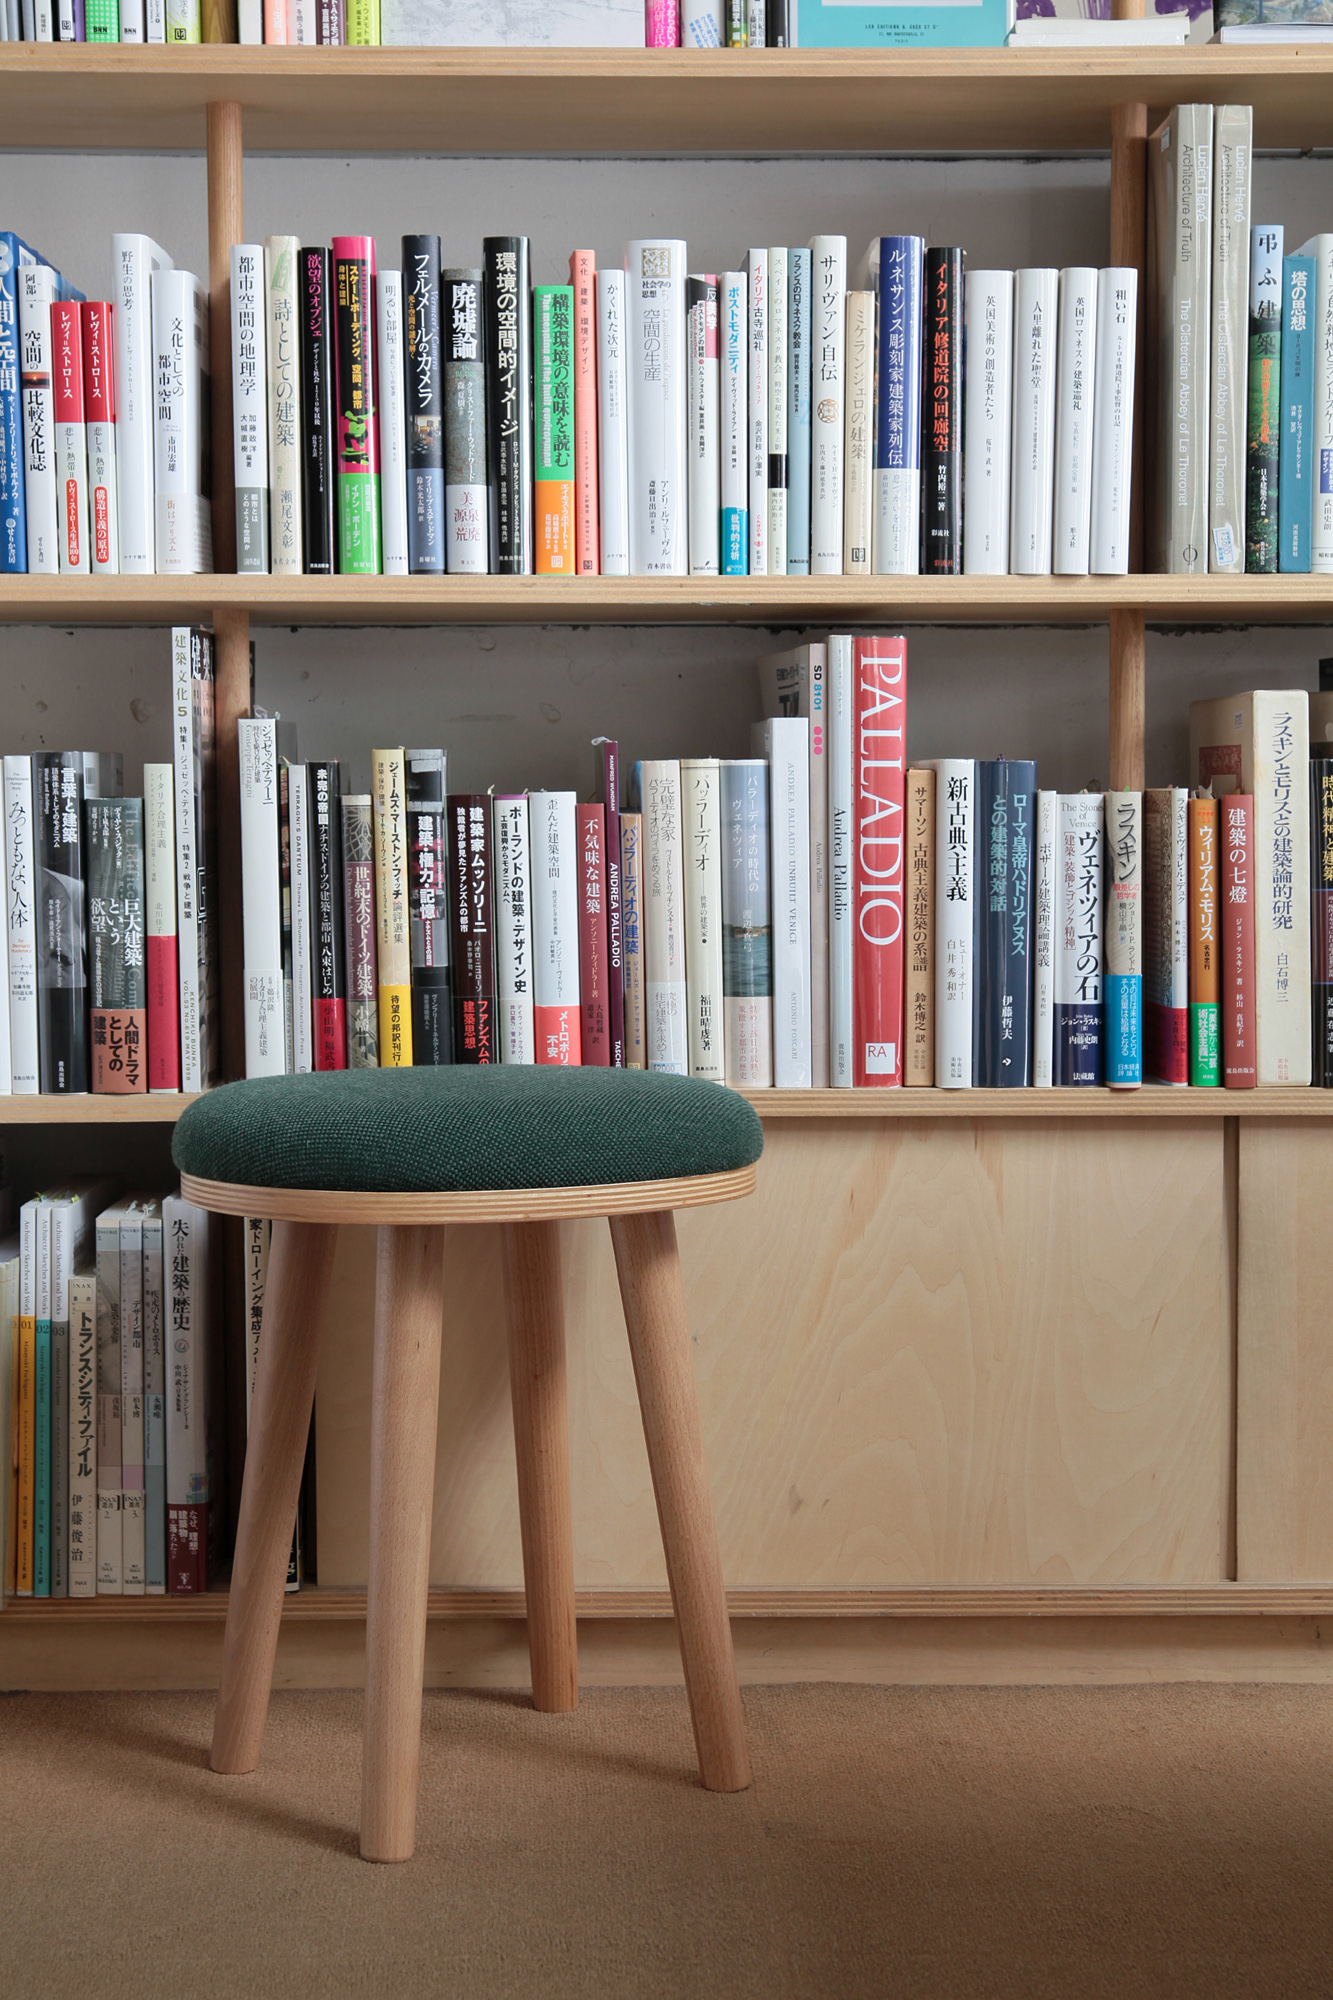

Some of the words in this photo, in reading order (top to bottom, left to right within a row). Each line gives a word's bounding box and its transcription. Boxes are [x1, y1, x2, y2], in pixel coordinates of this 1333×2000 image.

[124, 27, 137, 35] BNN
[1181, 144, 1194, 214] Architecture
[1197, 145, 1209, 183] Lucien
[1220, 144, 1232, 215] Architecture
[1236, 145, 1247, 183] Lucien
[1181, 218, 1192, 229] of
[1196, 186, 1208, 222] Hervé
[1220, 218, 1231, 230] of
[1234, 187, 1246, 223] Hervé
[1181, 232, 1192, 262] Truth
[1219, 233, 1230, 262] Truth
[121, 251, 134, 310] 野生の思考
[307, 254, 322, 337] 欲望のオブジェ
[543, 294, 551, 311] The
[642, 281, 671, 289] 社会学の
[642, 290, 657, 298] 思想
[753, 265, 764, 351] イタリア古寺巡礼
[793, 255, 801, 349] フランスのロマネスク教会
[1115, 289, 1127, 324] 粗い石
[1291, 271, 1307, 331] 塔の思想
[238, 256, 256, 396] 都市空間の地理学
[385, 285, 397, 344] 明るい部屋
[408, 295, 416, 359] 光と空間の謎を解く
[413, 254, 433, 408] フェルメールのカメラ
[431, 290, 439, 334] Vermeer's
[452, 282, 477, 359] 廃墟論
[543, 312, 551, 353] meaning
[580, 258, 589, 374] 文化・建築・環境デザイン
[607, 285, 619, 358] かくれた次元
[728, 286, 739, 374] ポストモダニティ
[774, 259, 782, 373] スペインのロマネスク教会
[820, 255, 838, 381] サリヴァン自伝
[1180, 298, 1191, 320] The
[1218, 299, 1229, 320] The
[25, 330, 42, 371] 空間の
[170, 318, 184, 397] 文化としての
[273, 299, 295, 446] 詩としての建築
[431, 336, 439, 370] Camera
[496, 252, 518, 437] 環境の空間的イメージ
[543, 355, 551, 365] of
[643, 309, 661, 381] 空間の生産
[888, 249, 906, 465] ルネサンス彫刻家建築家列伝
[985, 296, 996, 420] 英国美術の創造者たち
[1031, 301, 1043, 389] 人里離れた聖堂
[1072, 297, 1085, 411] 英国ロマネスク建築巡礼
[1179, 323, 1191, 379] Cistercian
[1217, 323, 1229, 379] Cistercian
[158, 354, 171, 420] 都市空間
[543, 367, 551, 381] the
[543, 384, 551, 405] built
[552, 294, 570, 467] 構築環境の意味を読む
[850, 310, 867, 459] ミケランジェロの建築
[1178, 382, 1190, 418] Abbey
[1215, 382, 1228, 418] Abbey
[27, 390, 47, 471] 比較文化誌
[240, 415, 248, 453] 大城直樹
[249, 415, 257, 452] 加藤政洋
[543, 407, 552, 467] environment
[1178, 421, 1189, 433] of
[1178, 437, 1189, 452] Le
[1216, 421, 1227, 434] of
[1216, 437, 1227, 452] Le
[938, 465, 947, 501] 竹内裕二
[938, 502, 946, 511] 著
[1178, 455, 1189, 506] Thoronet
[1215, 455, 1227, 507] Thoronet
[243, 494, 251, 550] どのような空間か
[281, 490, 294, 549] 瀬尾文彰
[661, 480, 670, 556] アンリ・ルフェーヴル
[731, 514, 740, 560] 批判的分析
[931, 529, 950, 537] 彩流社
[1323, 499, 1332, 531] 武田史朗
[7, 528, 16, 563] せりか書房
[175, 634, 188, 701] 建築文化
[814, 665, 822, 680] SD
[177, 706, 187, 717] 5
[814, 684, 822, 711] 8101
[179, 726, 187, 751] 特集1
[262, 725, 273, 805] ジュゼッペ・テラーニ
[61, 768, 77, 843] 言葉と建築
[181, 756, 189, 834] ジュゼッペ・テラーニ
[660, 778, 676, 841] 完璧な家
[787, 762, 795, 803] ANDREA
[859, 653, 903, 945] PALLADIO
[1061, 802, 1077, 812] The
[1080, 803, 1104, 812] Stones
[157, 773, 166, 849] イタリア合理主義
[389, 762, 402, 899] ジェームズ・マーストン・フィッチ
[547, 799, 560, 878] 歪んだ建築空間
[693, 775, 711, 871] パッラーディオ
[732, 799, 743, 869] ヴェネツィア
[788, 807, 796, 856] PALLADIO
[834, 806, 847, 858] Andrea
[915, 787, 927, 836] サマーソン
[946, 777, 968, 901] 新古典主義
[1069, 820, 1096, 828] Venice
[1272, 712, 1294, 930] ラスキンとモリスとの建築論的研究
[9, 802, 28, 929] みっともない人体
[182, 844, 190, 869] 特集2
[418, 816, 435, 919] 建築・権力・記憶
[469, 807, 487, 933] 建築家ムッソリーニ
[501, 815, 510, 903] 工芸復興からモダニズムへ
[584, 819, 600, 914] 不気味な建築
[990, 795, 1007, 912] との建築的対話
[1117, 803, 1137, 882] ラスキン
[1228, 808, 1247, 903] 建築の七燈
[183, 873, 192, 919] 戦争と建築
[510, 807, 526, 993] ポーランドの建築・デザイン史
[610, 862, 619, 909] ANDREA
[623, 826, 639, 955] パッラーディオの建築
[788, 860, 796, 903] UNBUILT
[834, 864, 847, 921] Palladio
[1012, 794, 1027, 956] ローマ皇帝ハドリアヌス
[1199, 826, 1214, 941] ウィリアム・モリス
[125, 898, 142, 966] 巨大建築
[354, 866, 373, 996] 世紀末のドイツ建築
[789, 908, 797, 945] VENICE
[913, 843, 928, 972] 古典主義建築の系譜
[1075, 830, 1100, 1001] ヴェネツィアの石
[610, 912, 621, 968] PALLADIO
[1276, 953, 1289, 1003] 白石博三
[463, 1001, 476, 1049] 建築思想
[914, 993, 926, 1031] 鈴木博之
[916, 1034, 925, 1043] 訳
[1002, 995, 1013, 1040] 伊藤哲夫
[1120, 978, 1129, 1056] その言葉は絵画となる
[109, 1017, 123, 1072] としての
[125, 1016, 139, 1086] 人間ドラマ
[868, 1046, 887, 1058] RA
[172, 1219, 191, 1331] 失われた建築の歴史
[36, 1325, 49, 1333] 02
[53, 1328, 65, 1336] 03
[132, 1301, 141, 1348] デザイン都市
[78, 1312, 94, 1478] トランス・シティ・ファイル
[71, 1494, 83, 1561] 伊藤俊治
